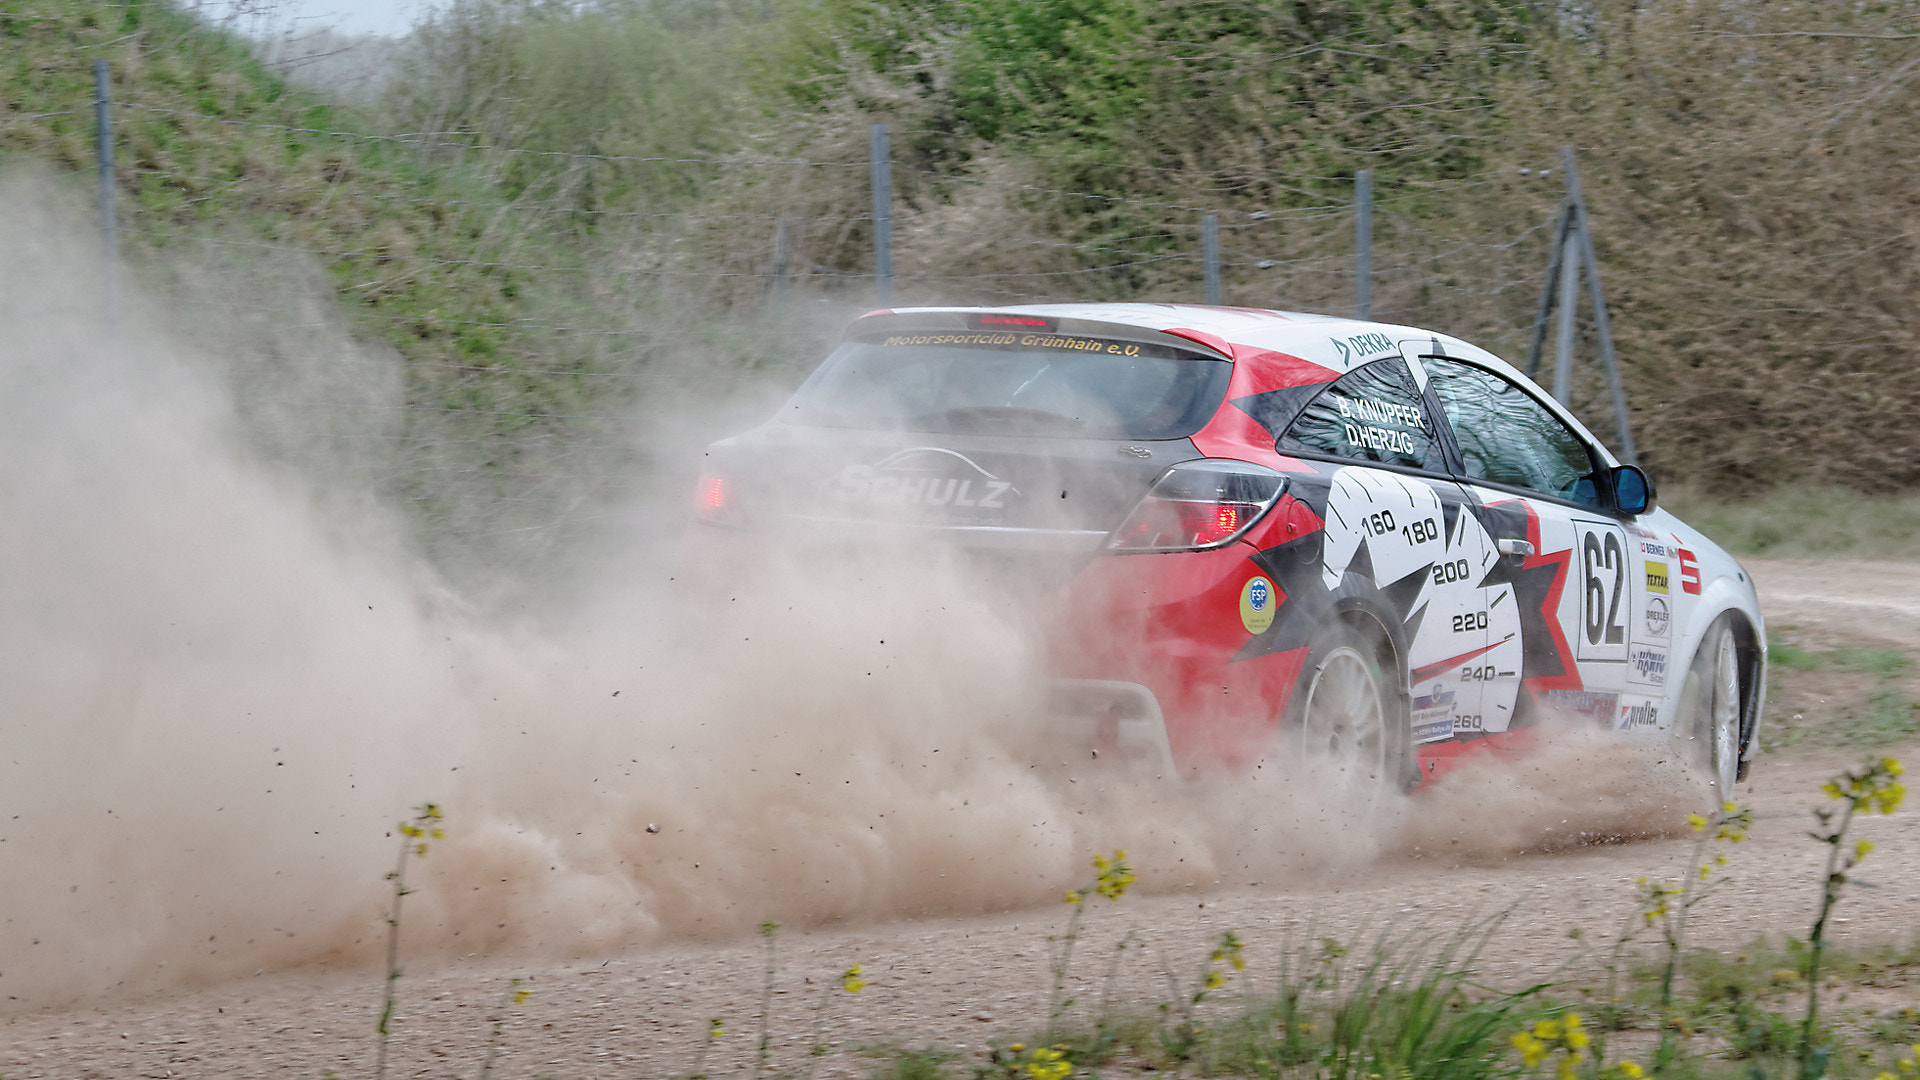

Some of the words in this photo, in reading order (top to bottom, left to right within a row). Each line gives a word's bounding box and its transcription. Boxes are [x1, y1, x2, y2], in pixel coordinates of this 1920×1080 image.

[883, 333, 1016, 347] Motorsportclub
[1020, 334, 1103, 352] Grünhain
[1106, 342, 1140, 358] e.V.
[1347, 332, 1396, 357] DEKRA
[1336, 396, 1356, 419] B.
[1354, 397, 1425, 429] KNÜPFER
[837, 463, 1012, 508] SCHULZ
[1361, 509, 1396, 538] 160
[1402, 517, 1438, 547] 180
[1432, 559, 1470, 585] 200
[1646, 573, 1669, 590] TEXTAR
[1252, 589, 1266, 601] FSP
[1583, 530, 1625, 646] 62
[1452, 611, 1488, 633] 220
[1461, 666, 1496, 682] 240
[1454, 715, 1482, 729] 260
